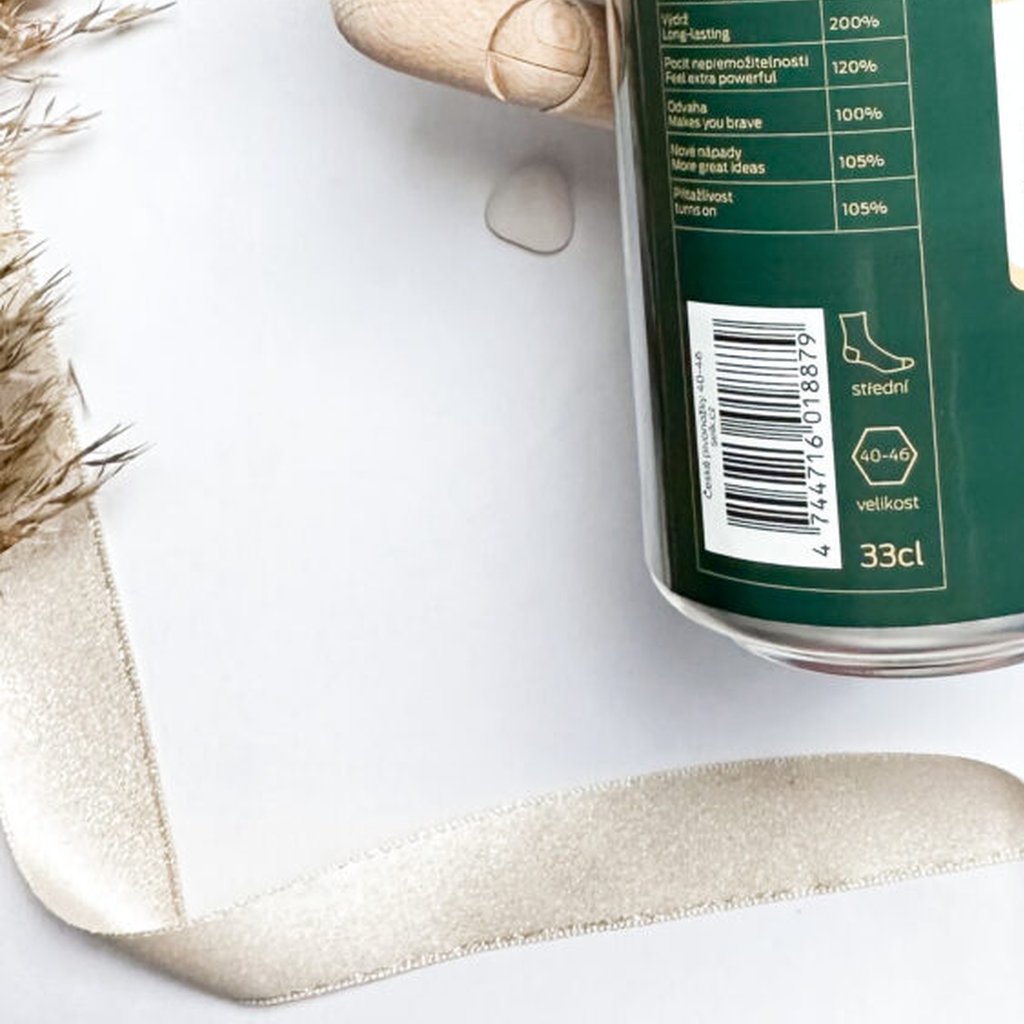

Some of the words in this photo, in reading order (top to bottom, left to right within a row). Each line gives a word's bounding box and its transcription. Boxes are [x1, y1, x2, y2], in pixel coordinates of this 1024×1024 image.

[829, 15, 880, 31] 200%
[662, 27, 731, 43] Long-lasting
[832, 59, 878, 75] 120%
[665, 71, 687, 85] Feel
[688, 71, 717, 85] extra
[718, 70, 778, 87] powerful
[667, 99, 708, 115] Odvaha
[835, 107, 884, 122] 100%
[668, 114, 701, 128] Makes
[703, 117, 725, 131] you
[726, 115, 763, 130] brave
[672, 158, 699, 172] More
[699, 160, 729, 176] great
[731, 160, 766, 175] ideas
[839, 154, 885, 169] 105%
[702, 205, 717, 218] on
[841, 201, 888, 216] 105%
[797, 332, 822, 424] 018879
[851, 378, 909, 397] střední
[860, 446, 910, 463] 40-46
[805, 435, 830, 525] 744716
[856, 495, 920, 512] velikost
[813, 543, 831, 557] 4
[859, 539, 925, 568] 33cl
